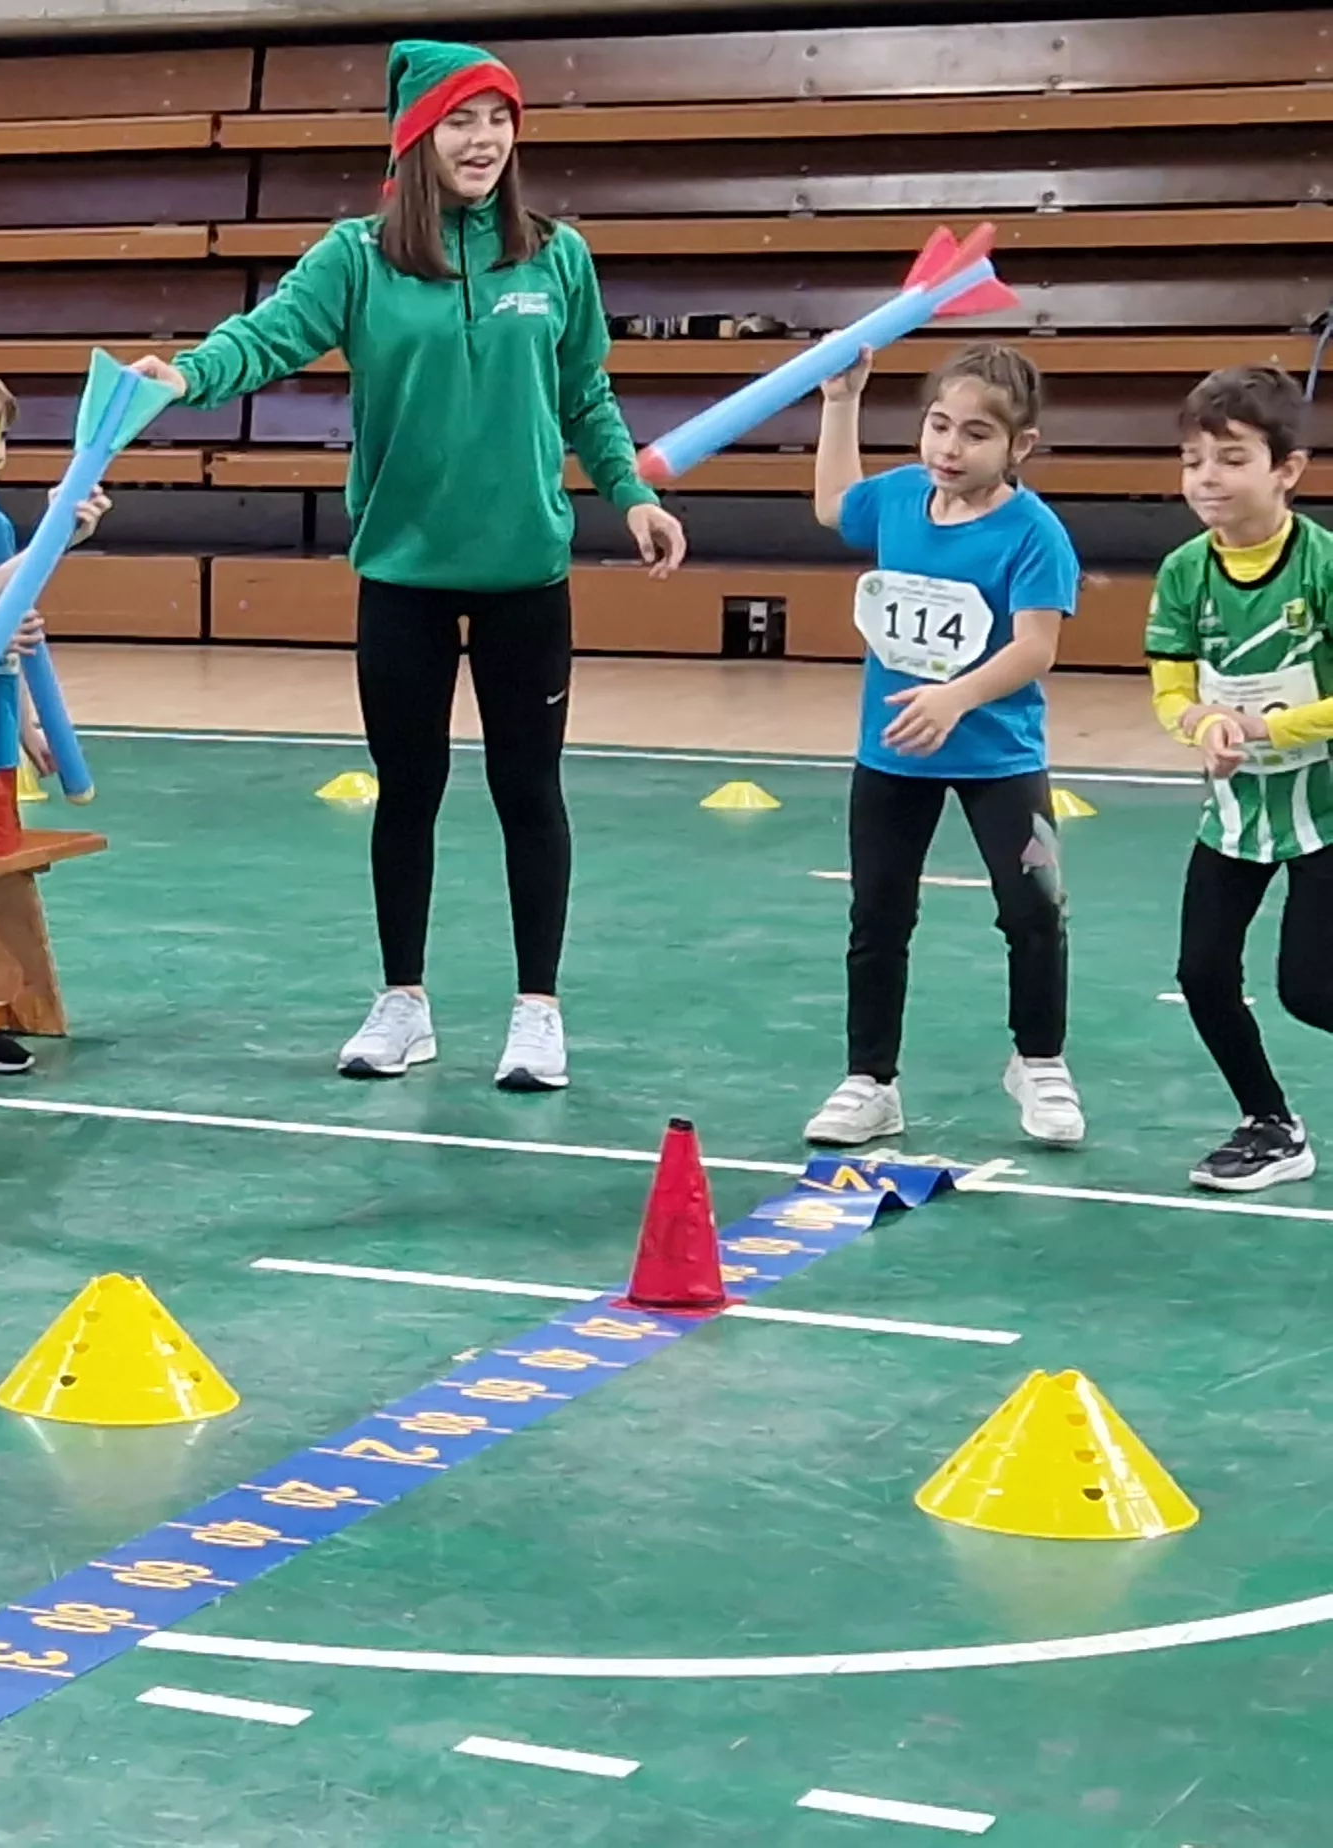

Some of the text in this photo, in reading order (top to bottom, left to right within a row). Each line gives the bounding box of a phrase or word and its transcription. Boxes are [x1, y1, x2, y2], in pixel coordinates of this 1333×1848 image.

[885, 601, 966, 651] 114
[341, 1439, 440, 1463] 2
[261, 1479, 359, 1509] 20
[191, 1520, 282, 1548] 40
[112, 1560, 214, 1590] 60
[31, 1602, 136, 1634] 80
